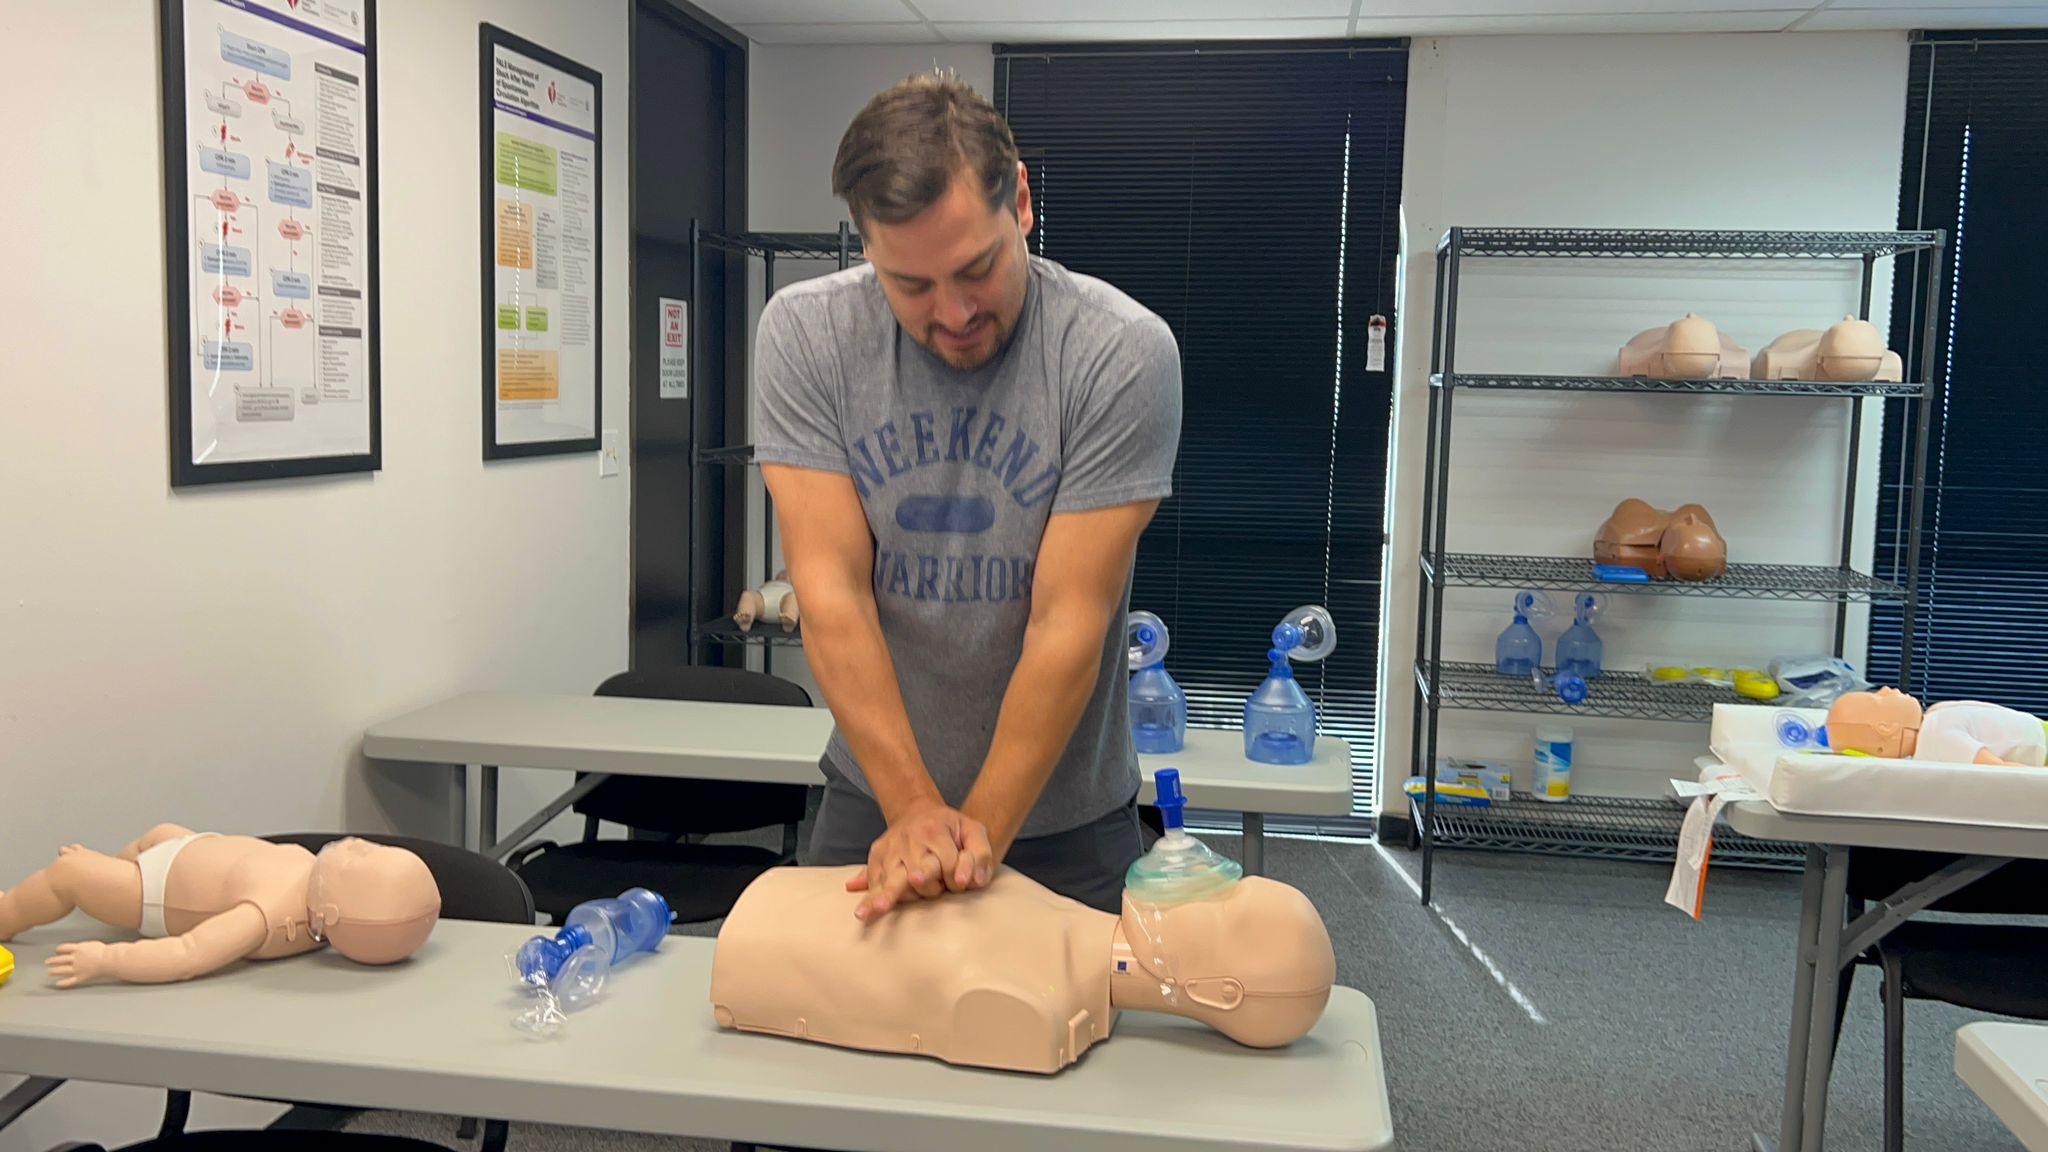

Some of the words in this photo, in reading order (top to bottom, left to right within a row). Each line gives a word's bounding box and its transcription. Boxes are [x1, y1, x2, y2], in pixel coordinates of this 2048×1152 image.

[667, 308, 681, 319] NOT
[670, 321, 679, 331] AN
[667, 332, 682, 343] EXIT
